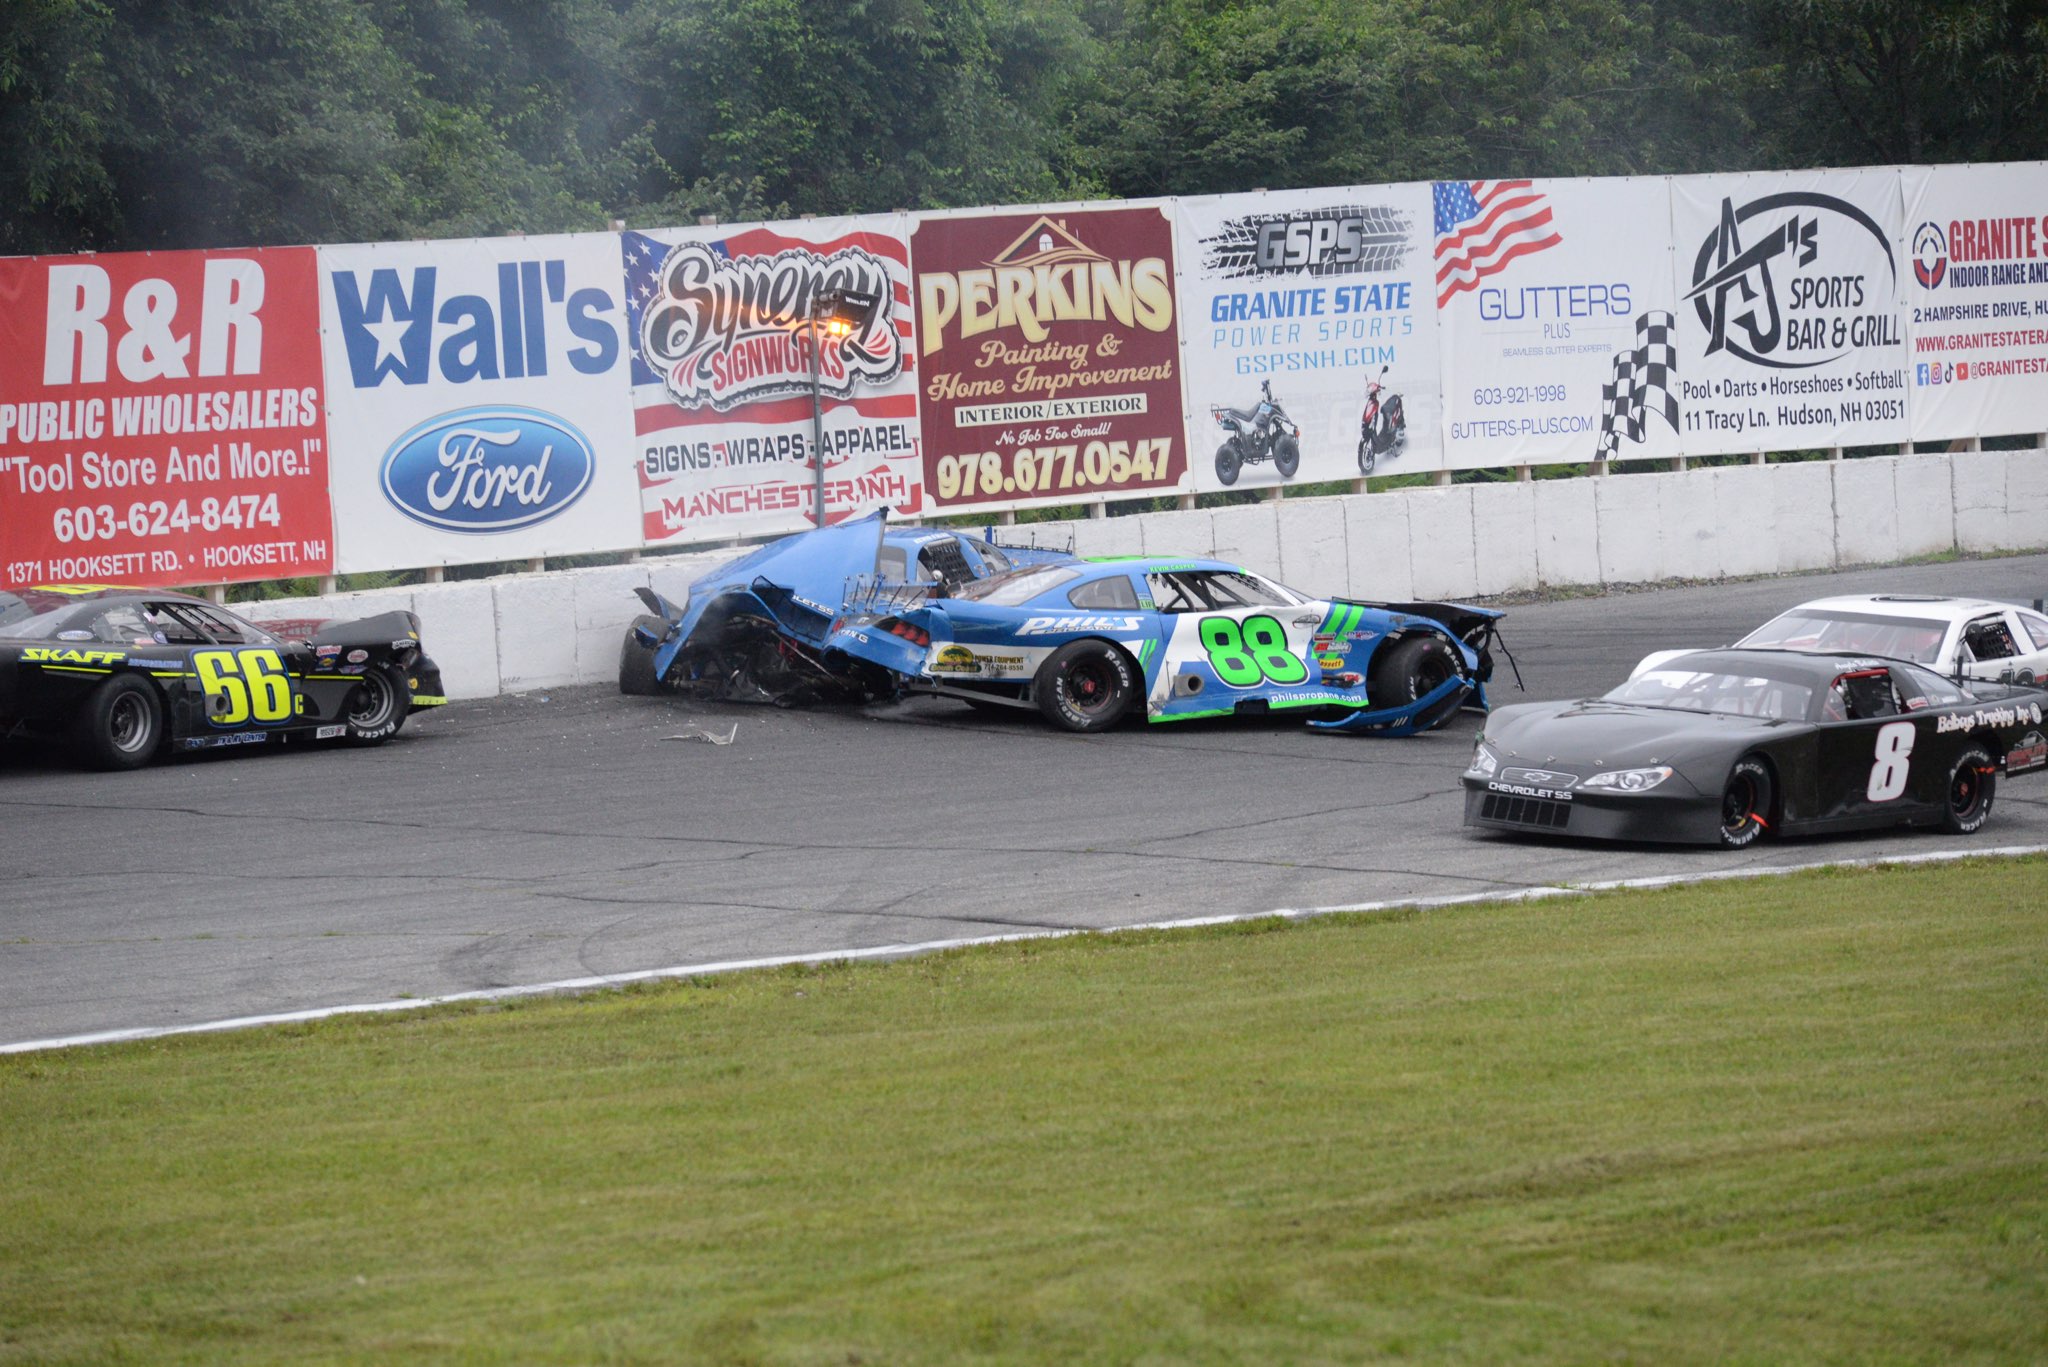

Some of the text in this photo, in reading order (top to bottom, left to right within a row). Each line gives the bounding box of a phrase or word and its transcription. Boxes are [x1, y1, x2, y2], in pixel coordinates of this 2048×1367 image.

[1256, 216, 1364, 269] GSPS
[1949, 217, 2037, 263] GRANITE
[1790, 275, 1864, 310] SPORTS
[1950, 265, 1989, 288] INDOOR
[1991, 263, 2026, 286] RANGE
[919, 258, 1173, 357] PERKINS
[1211, 282, 1411, 322] GRANITE STATE
[1479, 283, 1632, 321] GUTTERS
[1914, 308, 1921, 323] 2
[1924, 304, 1989, 321] HAMPSHIRE
[1993, 302, 2031, 319] DRIVE,
[43, 259, 265, 385] R&R
[331, 260, 619, 388] Wall's
[1213, 315, 1413, 349] POWER SPORTS
[1544, 323, 1571, 339] PLUS
[1787, 314, 1901, 351] BAR & GRILL
[711, 335, 845, 391] SIGNWORKS
[975, 333, 1122, 370] Painting &
[1236, 346, 1395, 375] GSPSNH.COM
[1502, 343, 1612, 357] SEAMLESS GUTTER EXPERTS
[1970, 358, 2048, 379] @GRANITEST
[928, 360, 1172, 401] Home Improvement
[1474, 385, 1566, 406] 603-921-1998
[1683, 369, 1903, 400] Pool Darts Horseshoes Softball
[0, 387, 317, 444] PUBLIC WHOLESALERS
[960, 397, 1142, 424] INTERIOR/EXTERIOR
[1451, 416, 1594, 439] GUTTERS-PLUS.COM
[1685, 400, 1904, 433] 11 Tracy Ln. Hudson, NH 03051
[646, 425, 912, 475] SIGNS WRAPS APPAREL
[996, 422, 1112, 446] No Job Too Small!
[0, 453, 73, 493] "Tool
[82, 452, 156, 489] Store
[166, 444, 219, 483] And
[427, 428, 553, 511] Ford
[937, 437, 1172, 499] 978.677.0547
[661, 475, 906, 521] MANCHESTER, NH
[54, 493, 280, 543] 603-624-8474
[7, 540, 326, 583] 1371 HOOKSETT RD. HOOKSETT, NH
[21, 648, 126, 665] SKAFF
[1104, 649, 1129, 688] RACER
[1200, 616, 1309, 688] 88
[193, 649, 292, 723] 66
[1271, 689, 1362, 703] philspropane.com
[356, 720, 396, 739] RACER
[1867, 722, 1916, 802] 8
[1488, 781, 1573, 800] CHEVROLET SS
